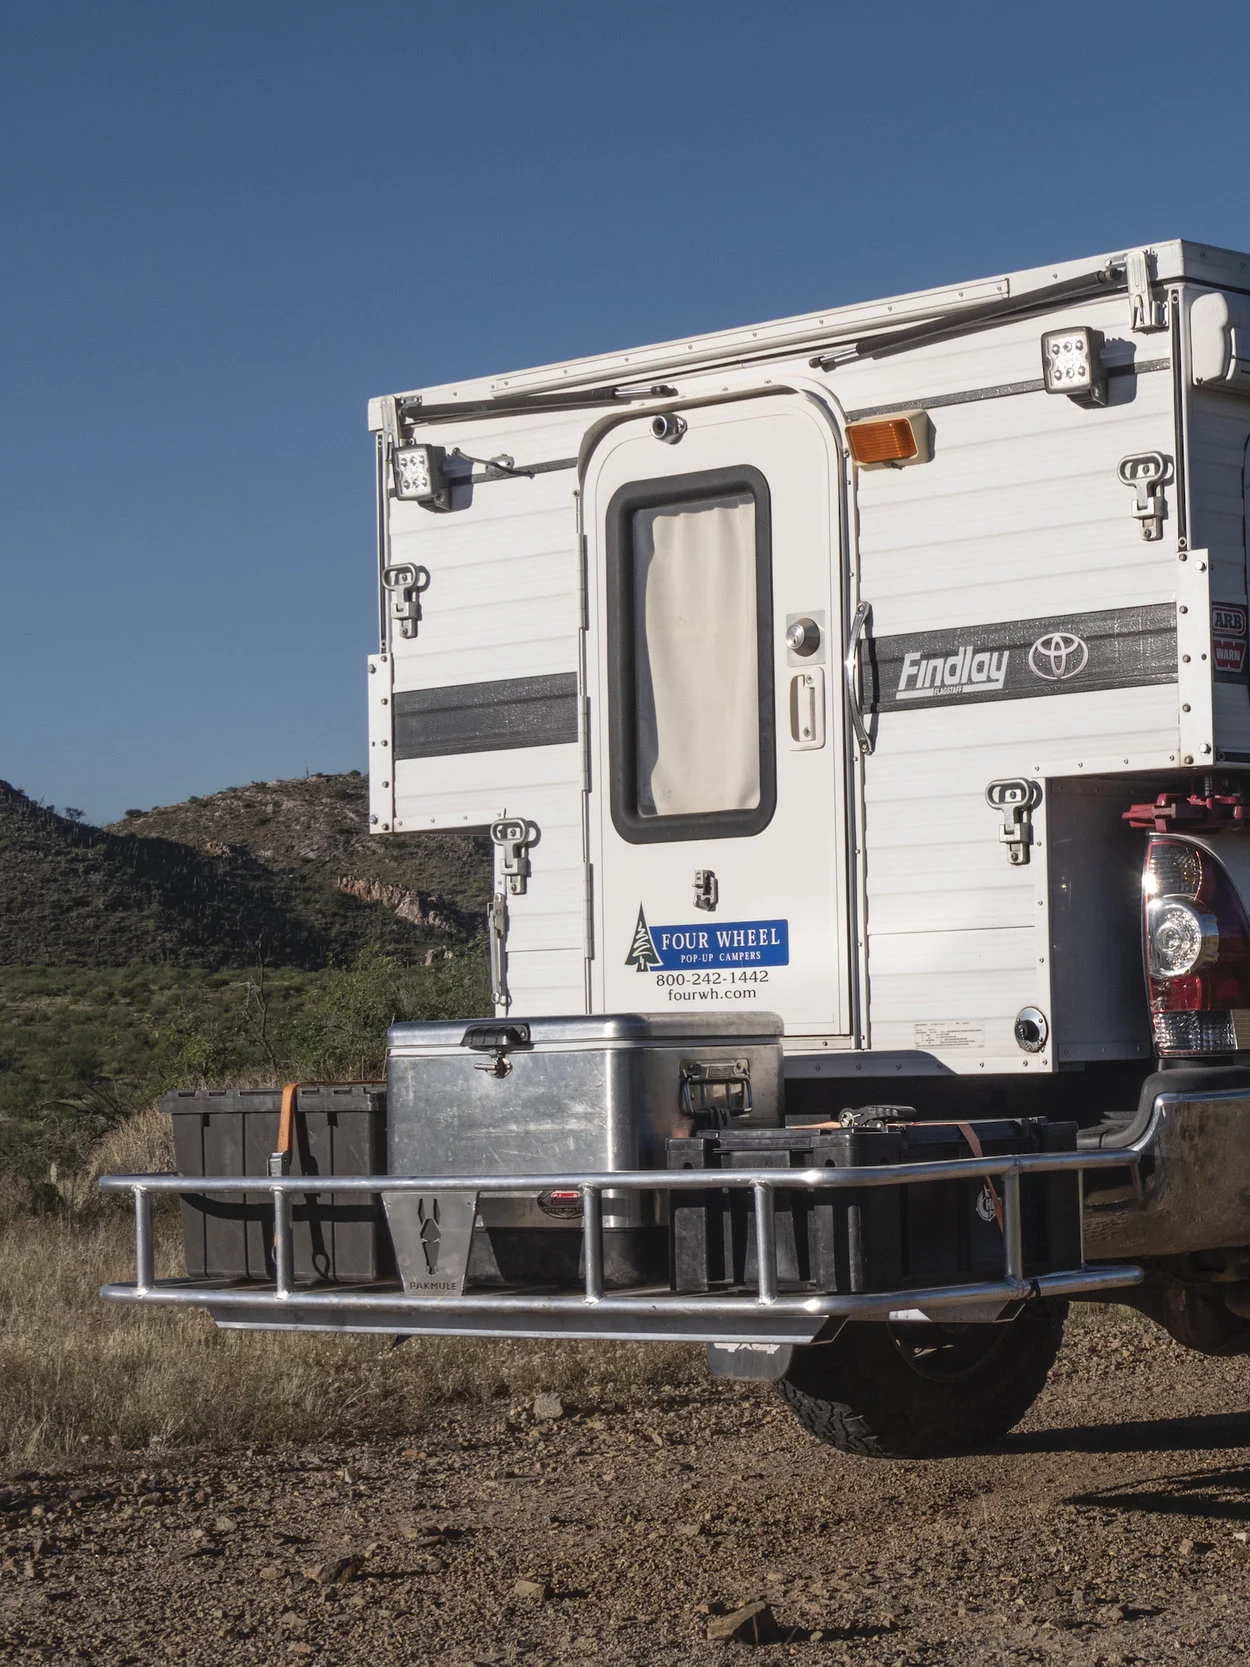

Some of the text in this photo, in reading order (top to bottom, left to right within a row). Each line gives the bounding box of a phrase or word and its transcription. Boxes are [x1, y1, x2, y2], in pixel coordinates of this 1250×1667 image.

[1214, 611, 1242, 629] ARB
[1215, 647, 1241, 661] WARN
[898, 646, 1010, 690] Findlay
[933, 686, 964, 696] FLAGSTAFF
[661, 928, 780, 950] FOUR WHEEL
[680, 951, 761, 963] POP-UP CAMPERS
[656, 970, 769, 987] 800-242-1442
[668, 987, 757, 1001] fourwh.com
[409, 1282, 457, 1291] PAKMULE
